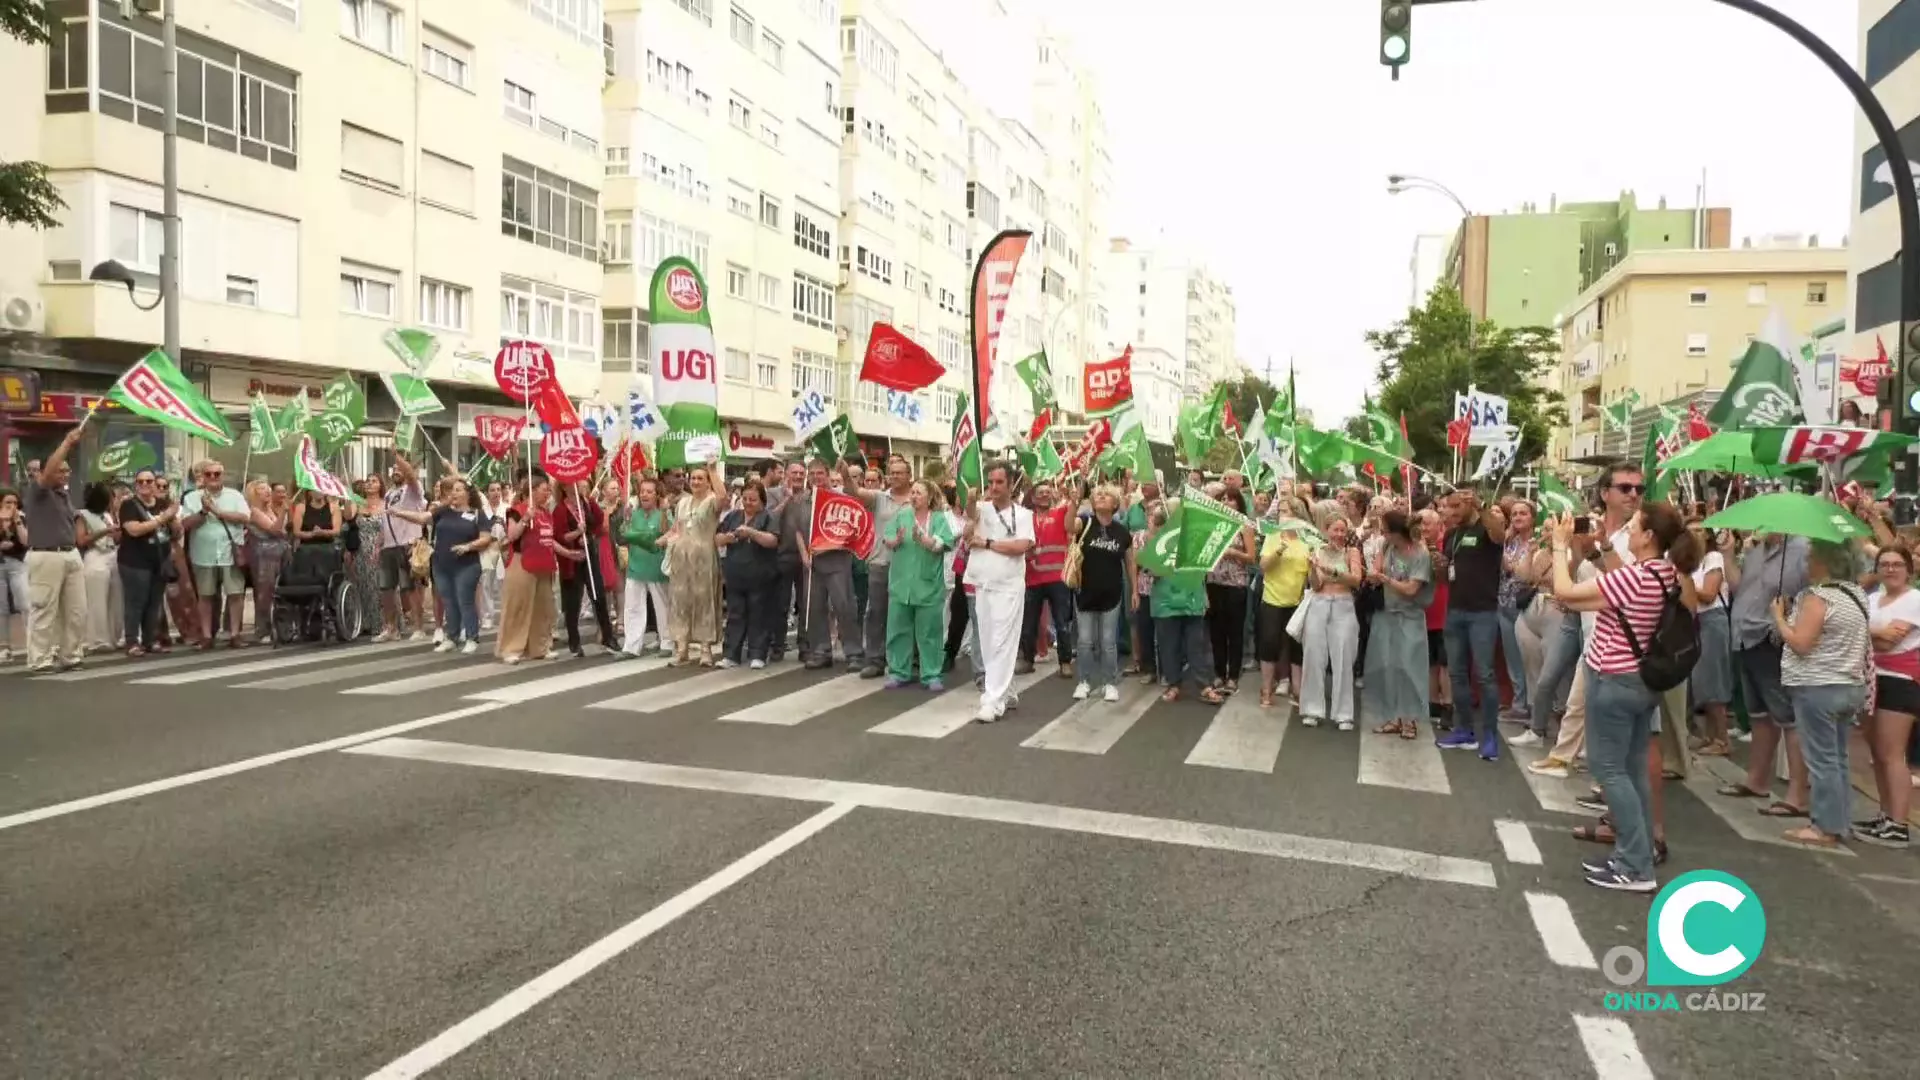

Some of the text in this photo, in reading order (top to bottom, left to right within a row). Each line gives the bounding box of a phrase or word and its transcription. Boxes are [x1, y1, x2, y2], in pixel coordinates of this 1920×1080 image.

[670, 274, 698, 295] UGT
[503, 346, 546, 371] UGT
[662, 349, 716, 384] UGT
[546, 428, 586, 450] UGT
[825, 502, 862, 528] UGT
